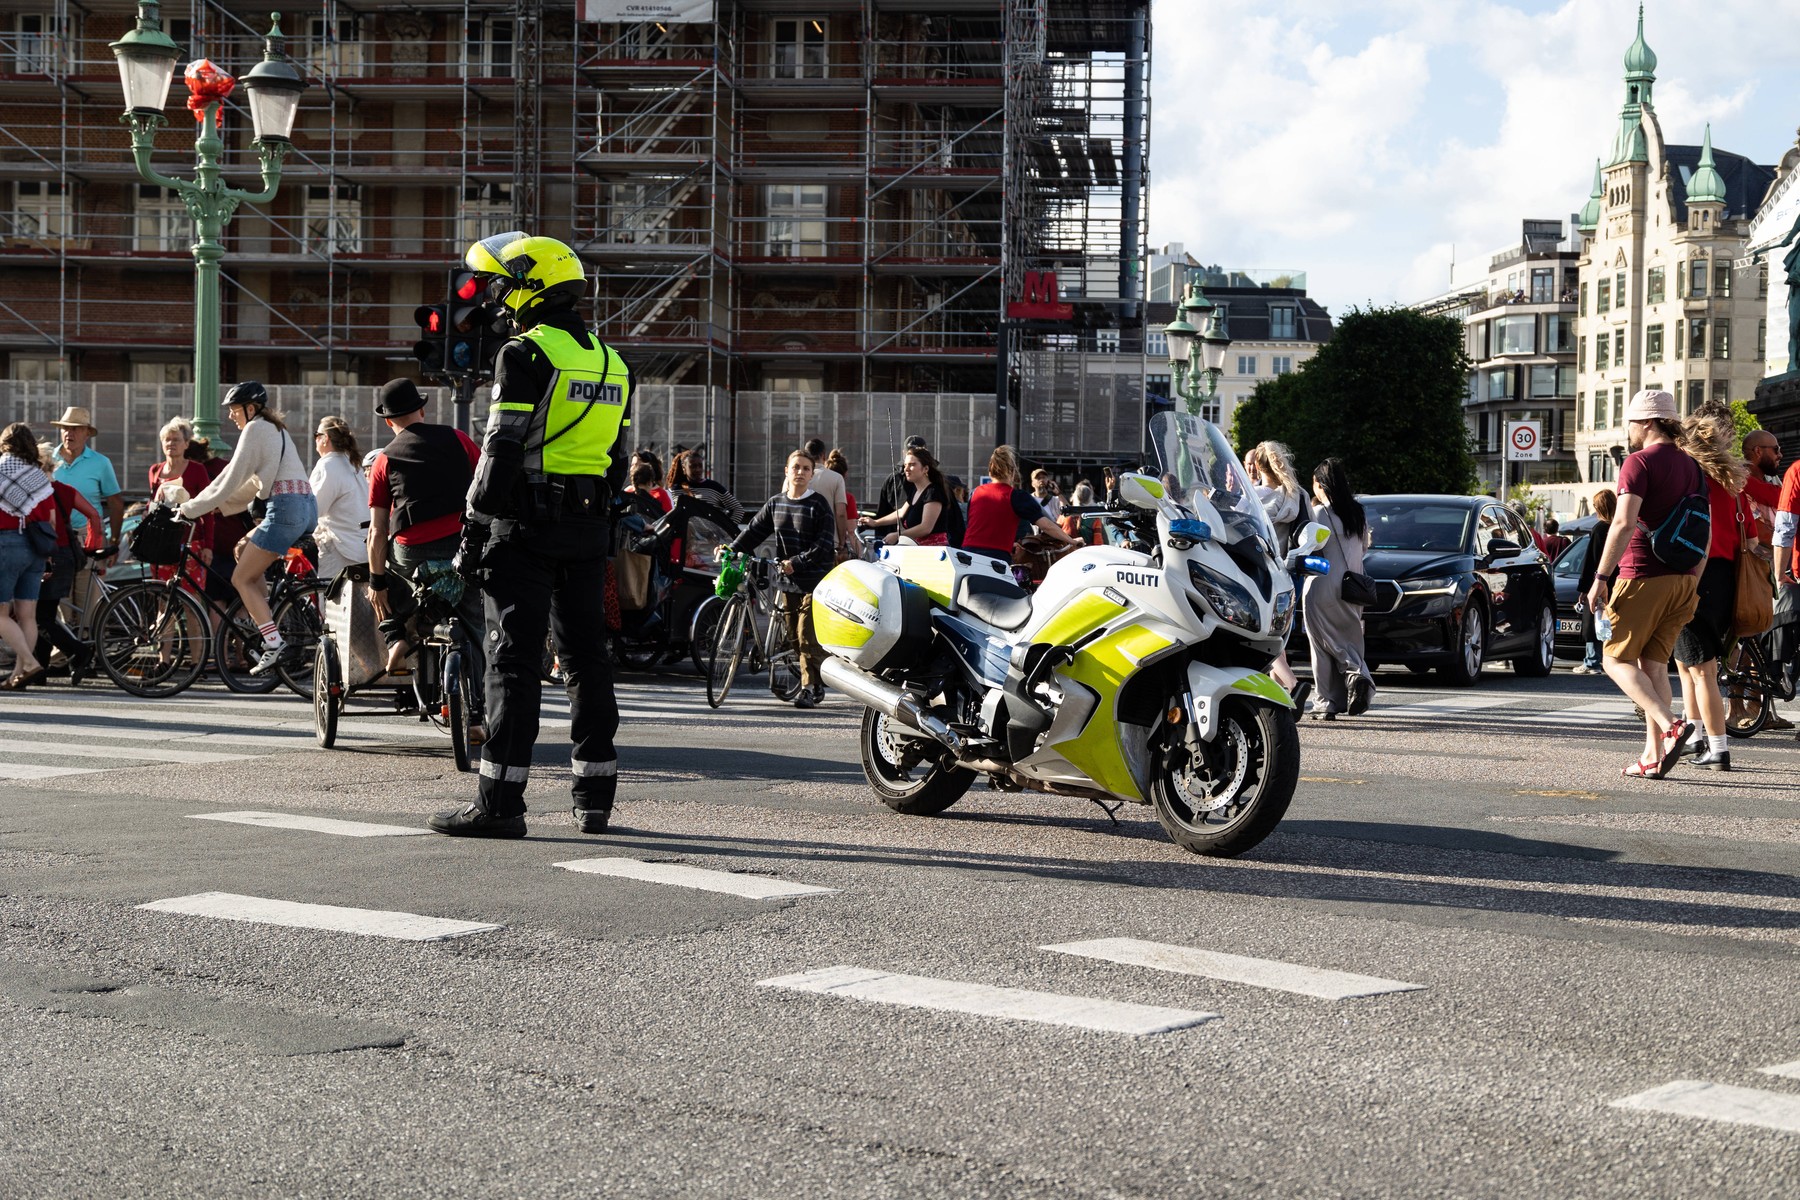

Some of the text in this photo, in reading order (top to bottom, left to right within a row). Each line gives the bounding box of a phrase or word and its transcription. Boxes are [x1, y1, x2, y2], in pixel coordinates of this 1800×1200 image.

[1023, 271, 1059, 304] M
[569, 382, 622, 403] POLITI
[1517, 433, 1532, 443] 30
[1116, 571, 1159, 587] POLITI
[1561, 621, 1573, 631] BX
